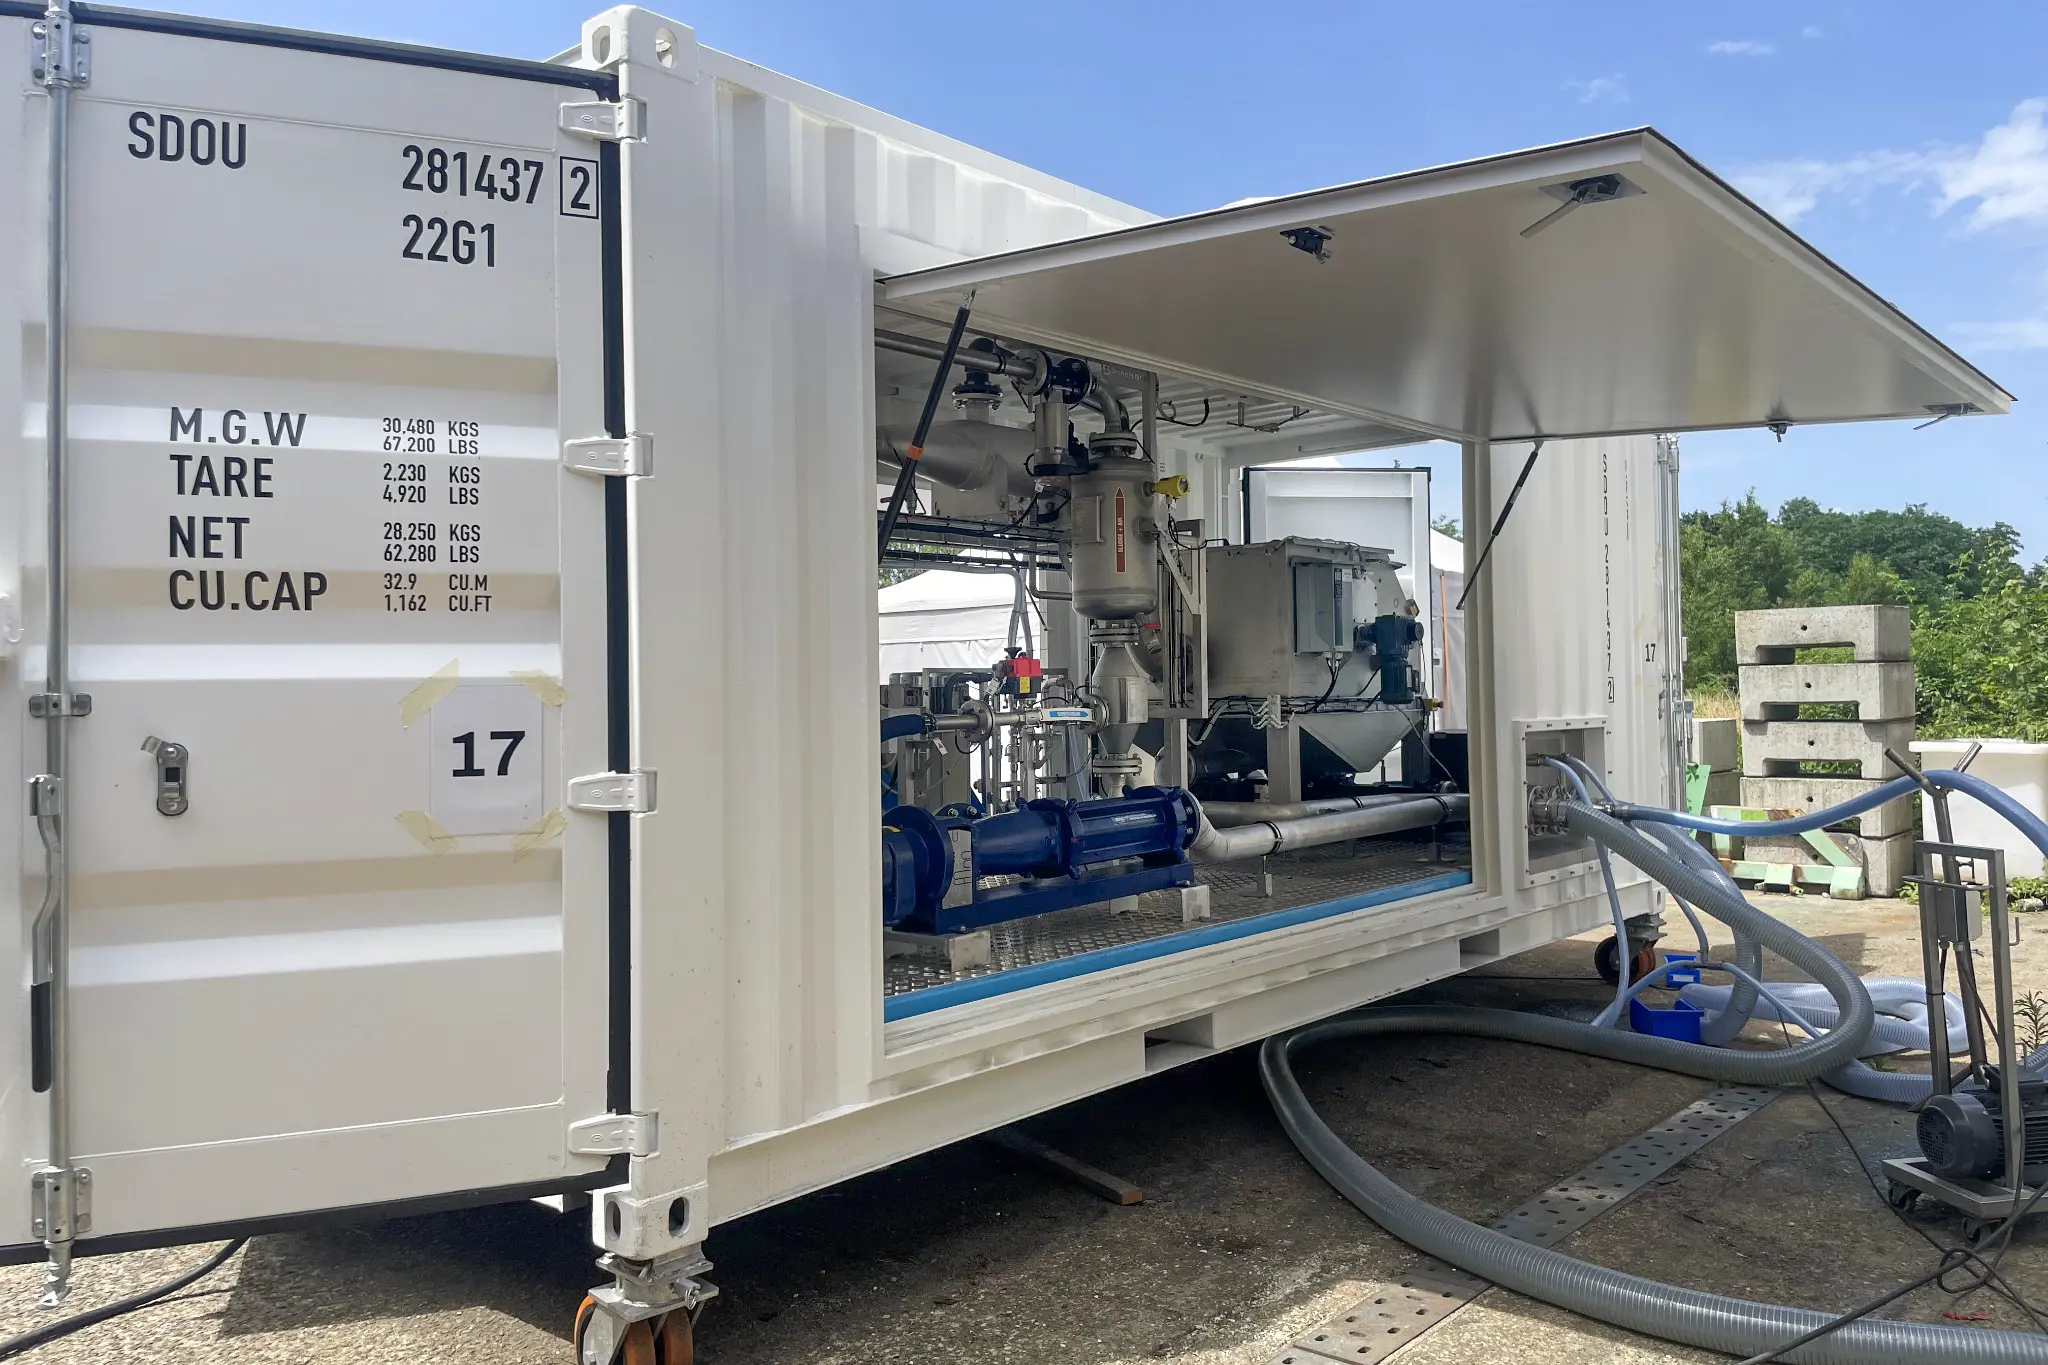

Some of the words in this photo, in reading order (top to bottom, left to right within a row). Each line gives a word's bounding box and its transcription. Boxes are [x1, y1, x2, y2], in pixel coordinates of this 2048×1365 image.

[128, 111, 248, 170] SDOU
[402, 144, 544, 204] 281437
[569, 166, 591, 211] 2
[402, 214, 496, 268] 22G1
[169, 407, 307, 447] M.G.W
[383, 417, 435, 435] 30,480
[448, 421, 479, 437] KGS
[383, 436, 435, 453] 67,200
[448, 439, 478, 455] LBS
[170, 454, 274, 498] TARE
[383, 463, 426, 482] 2,230
[449, 466, 480, 484] KGS
[383, 484, 426, 504] 4,920
[449, 487, 479, 505] LBS
[169, 516, 250, 560] NET
[383, 522, 436, 541] 28,250
[449, 524, 481, 542] KGS
[384, 544, 436, 563] 62,280
[449, 545, 479, 563] LBS
[169, 570, 328, 612] CU.CAP
[384, 573, 417, 590] 32.9
[449, 574, 488, 591] CU.M
[384, 594, 427, 612] 1,162
[449, 595, 492, 612] CU.FT
[1645, 642, 1657, 663] 17
[453, 730, 526, 777] 17
